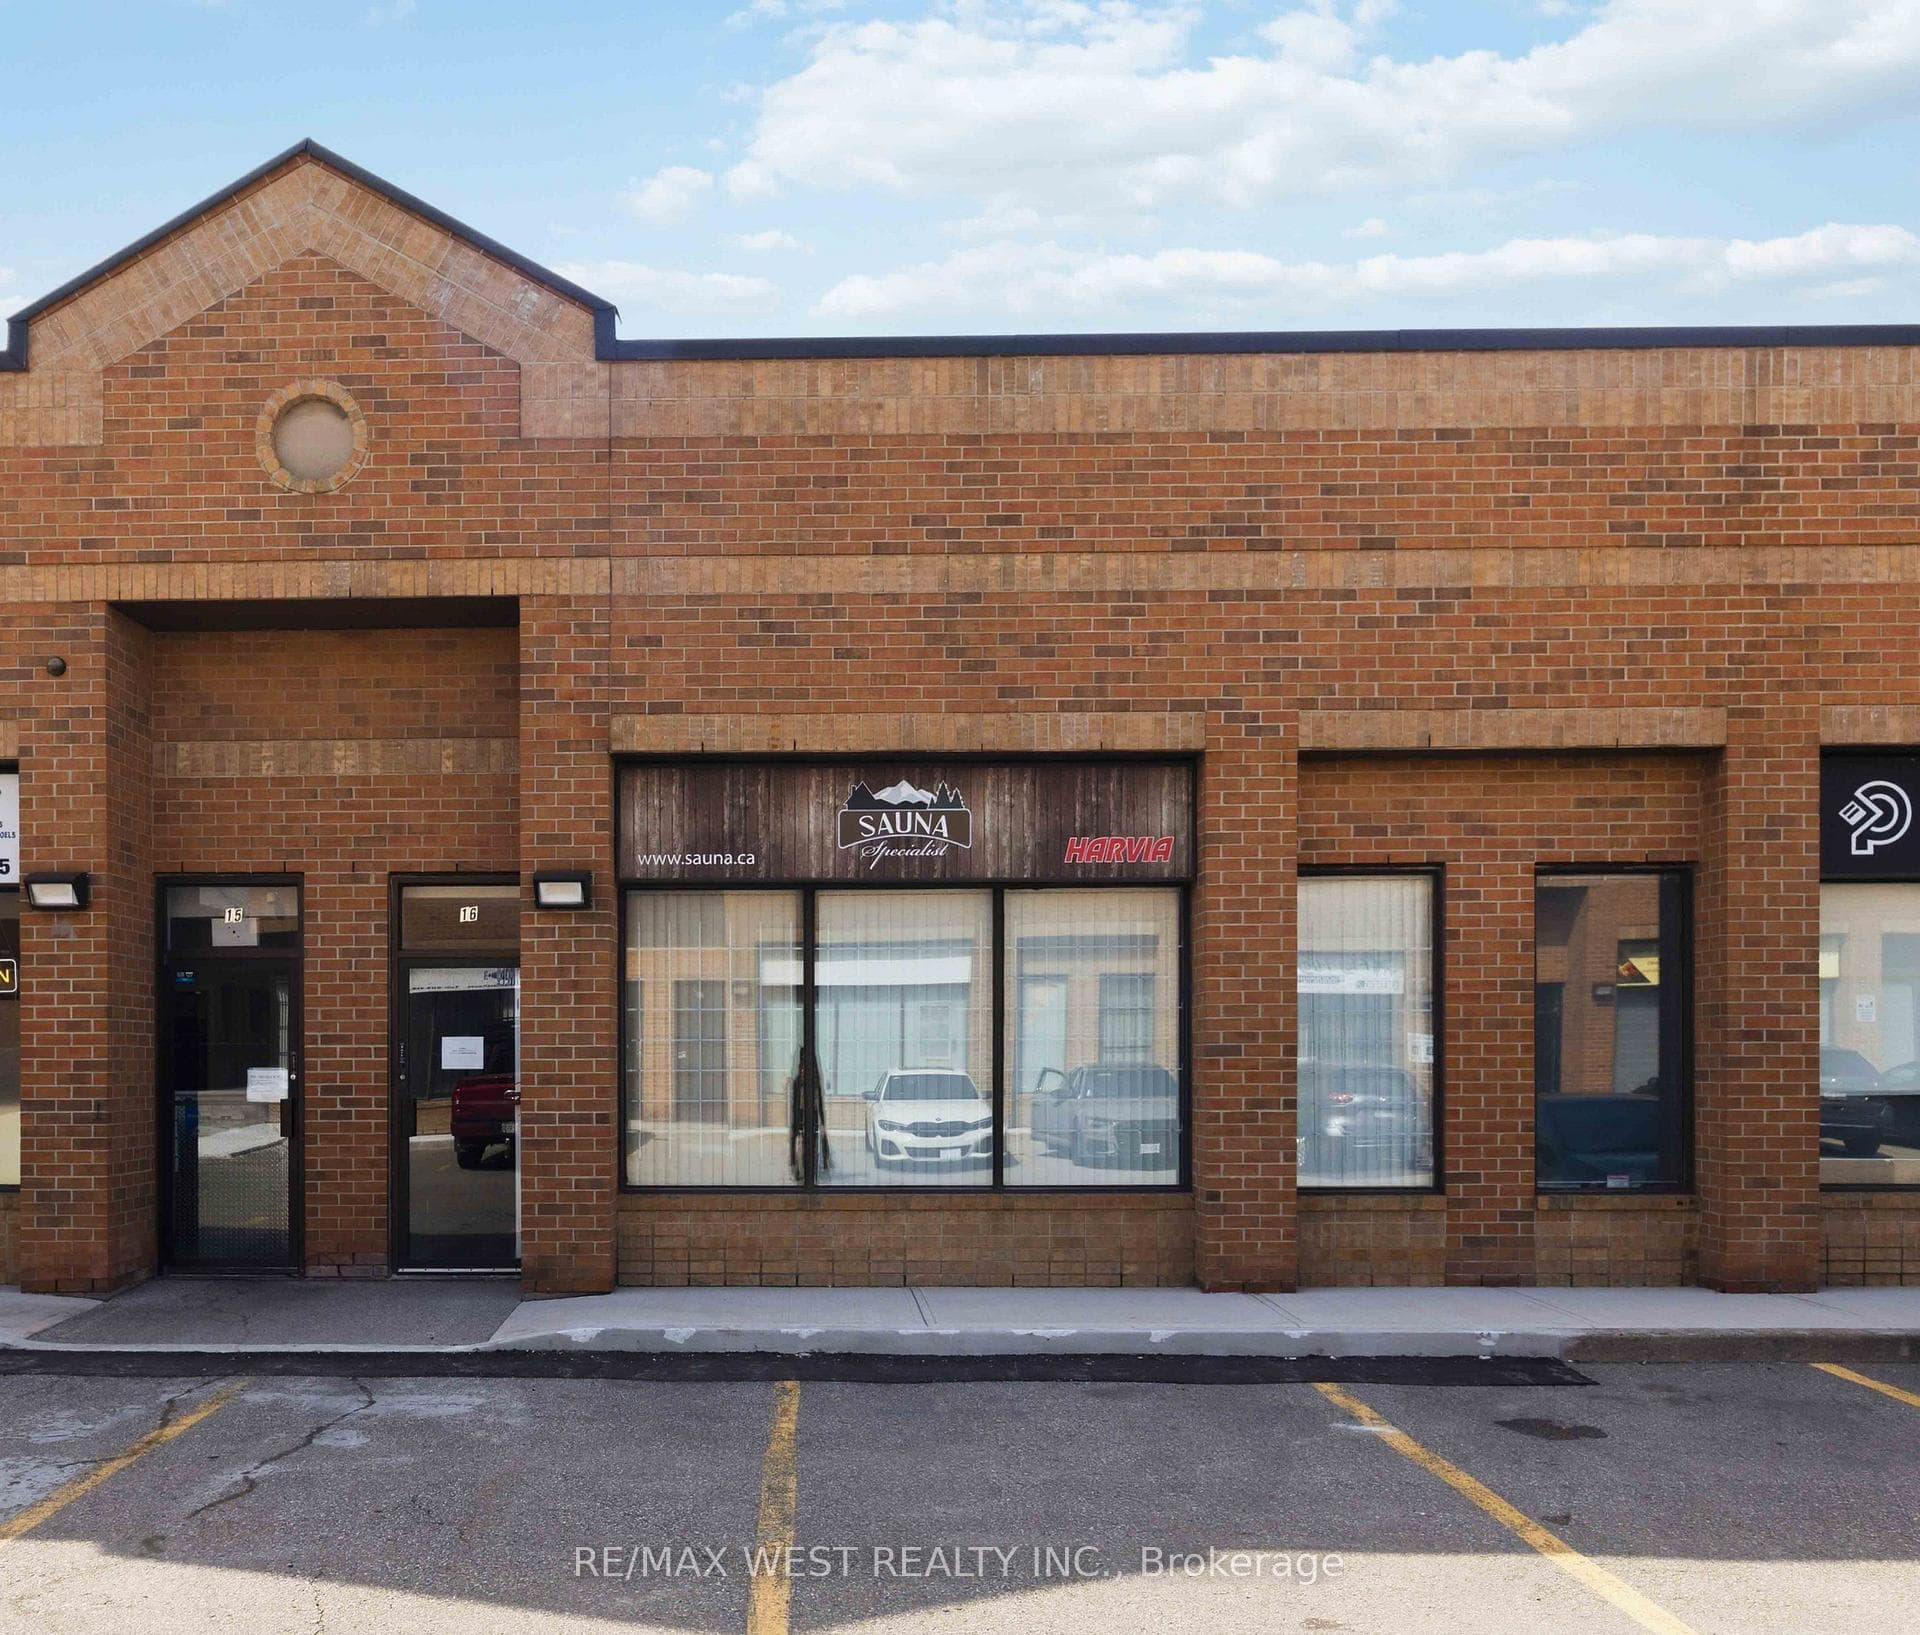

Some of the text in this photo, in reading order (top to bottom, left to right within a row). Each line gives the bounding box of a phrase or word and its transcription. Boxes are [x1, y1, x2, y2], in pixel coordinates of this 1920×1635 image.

[858, 811, 949, 838] SAUNA
[860, 839, 949, 870] Specialist
[1064, 836, 1174, 863] HARVIA
[0, 858, 11, 875] 5
[637, 852, 756, 866] www.sauna.ca
[227, 908, 243, 922] 15
[461, 907, 478, 921] 16
